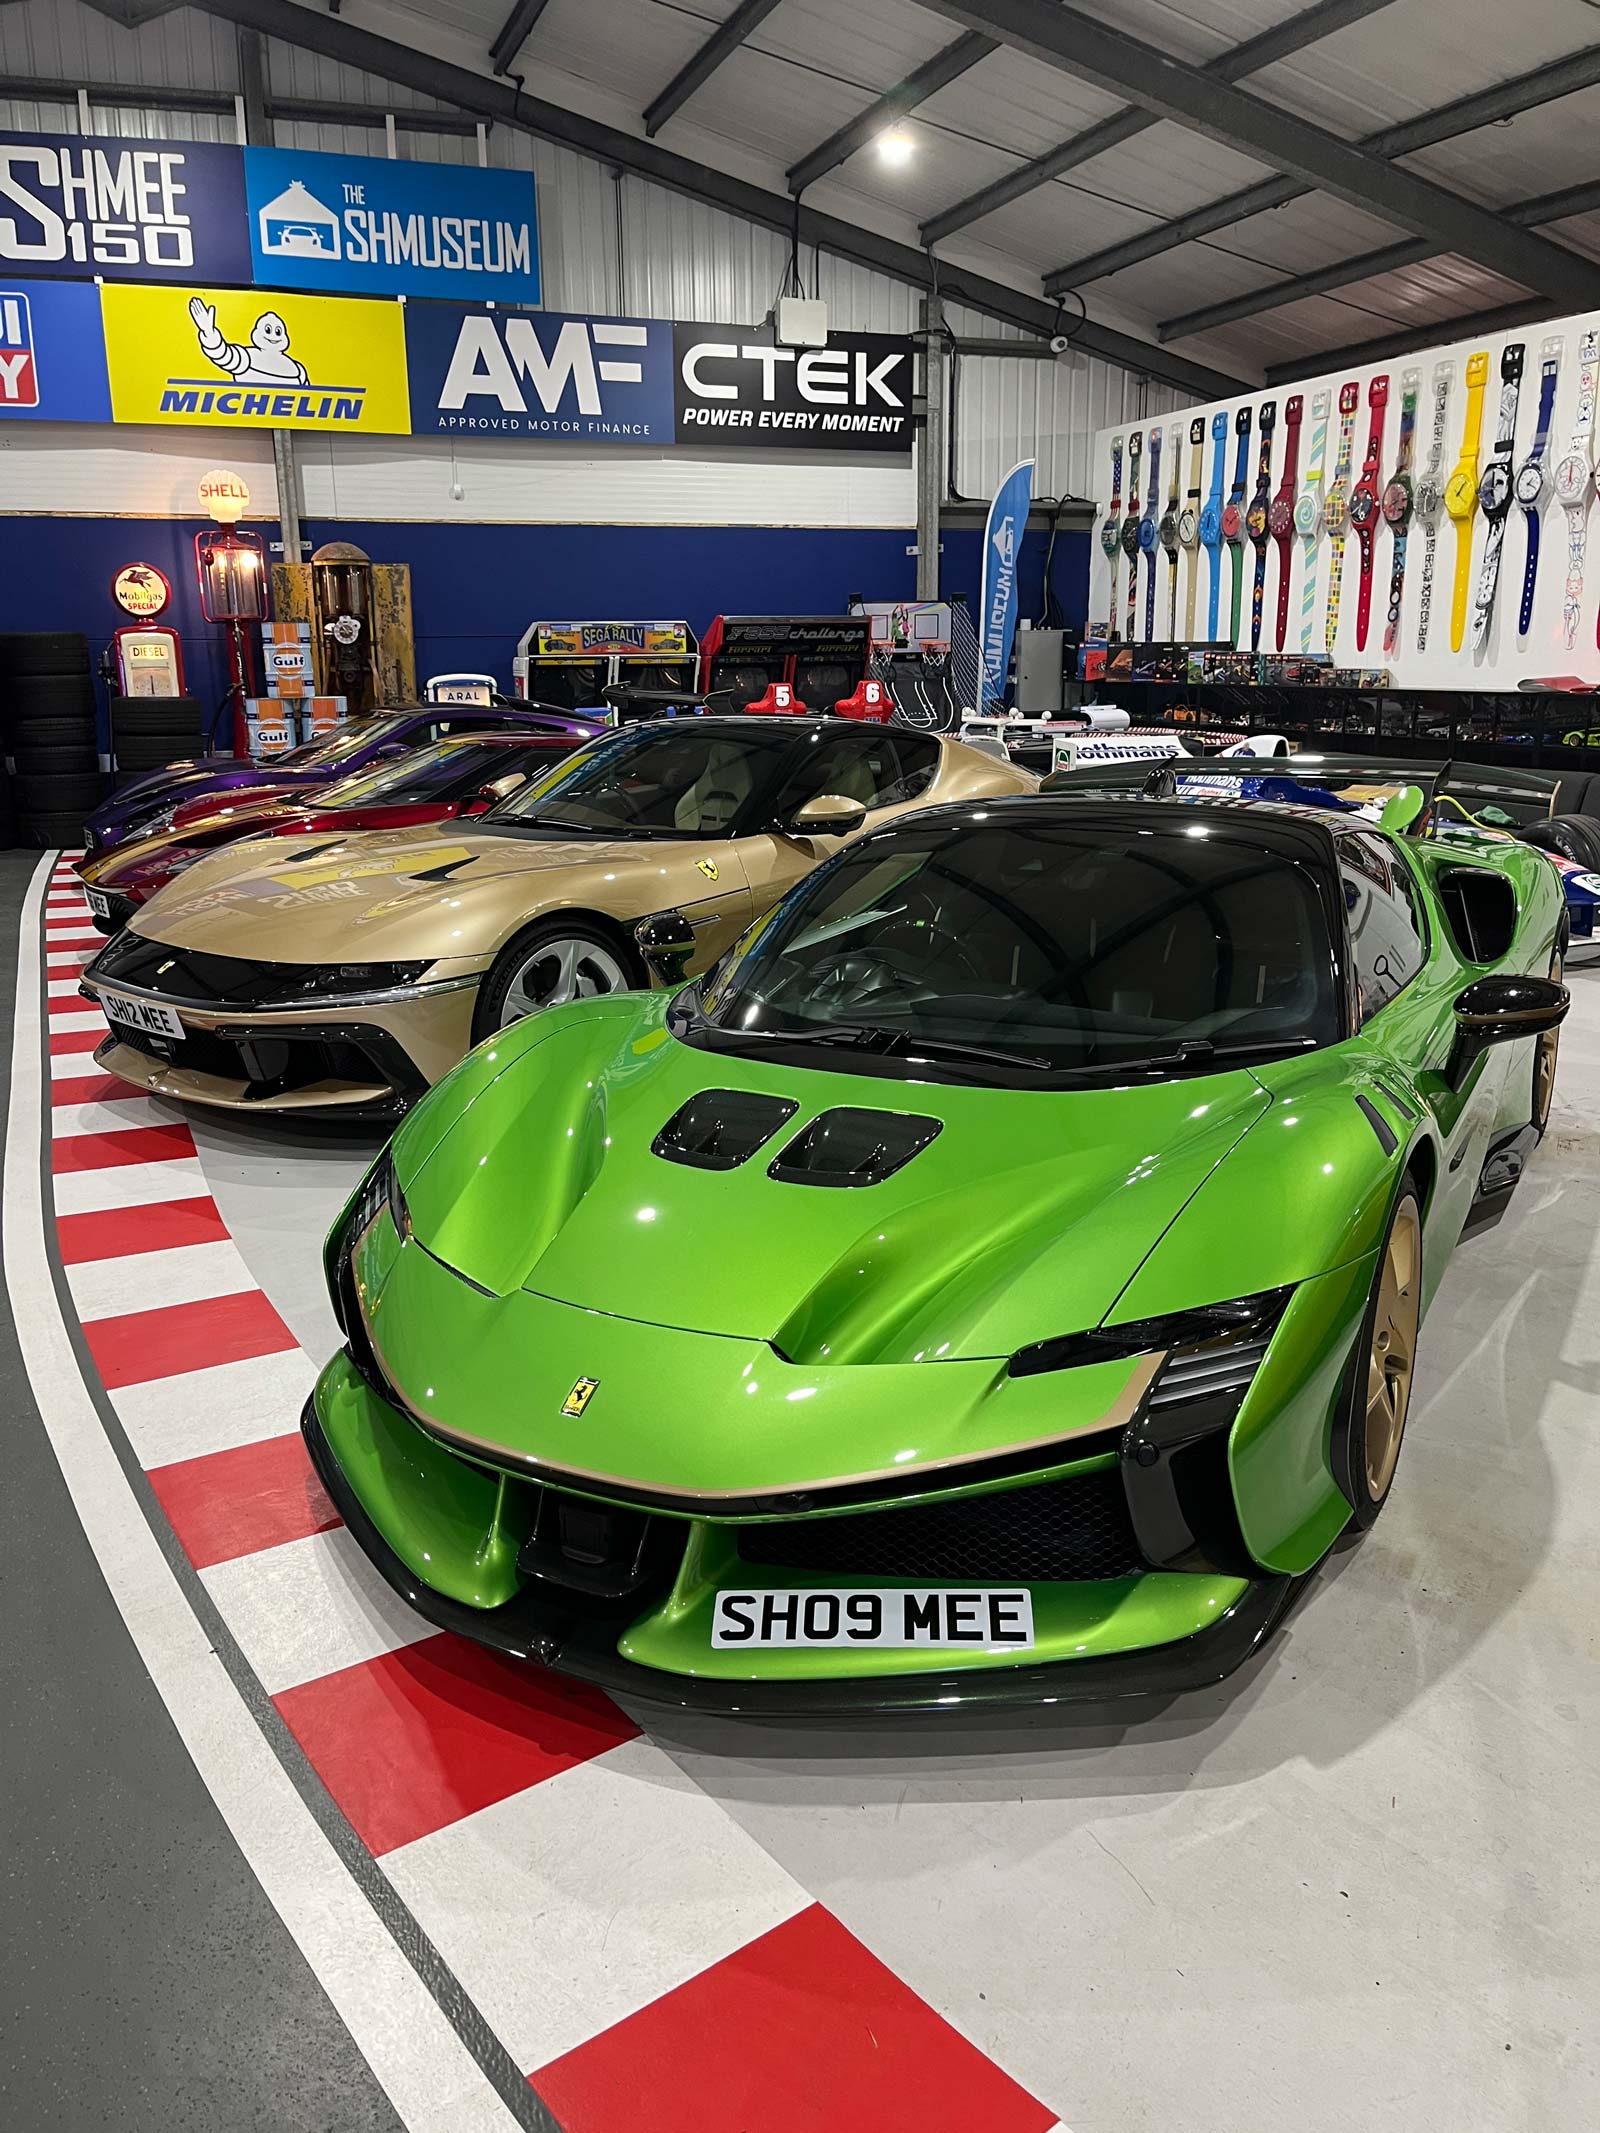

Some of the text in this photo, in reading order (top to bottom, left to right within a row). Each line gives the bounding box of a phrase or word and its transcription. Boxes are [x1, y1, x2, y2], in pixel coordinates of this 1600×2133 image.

[0, 144, 191, 261] SHMEE
[342, 184, 365, 205] THE
[67, 221, 194, 267] 150
[344, 208, 531, 275] SHMUSEUM
[437, 314, 648, 416] AMF
[681, 342, 905, 408] CTEK
[159, 389, 365, 420] MICHELIN
[438, 416, 651, 436] APPROVED MOTOR FINANCE
[682, 407, 905, 434] POWER EVERY MOMENT
[200, 483, 248, 498] SHELL
[119, 591, 163, 604] Mobilgas
[127, 602, 158, 610] SPECIAL
[583, 627, 644, 649] SEGA RALLY
[726, 625, 865, 644] F355 challenge
[133, 646, 165, 657] DIESEL
[273, 656, 305, 666] Gulf
[447, 691, 481, 701] ARAL
[775, 686, 790, 708] 5
[866, 683, 880, 704] 6
[257, 731, 290, 742] Gulf
[106, 995, 175, 1034] SH12 MEE
[719, 1594, 1027, 1642] SH09 MEE
